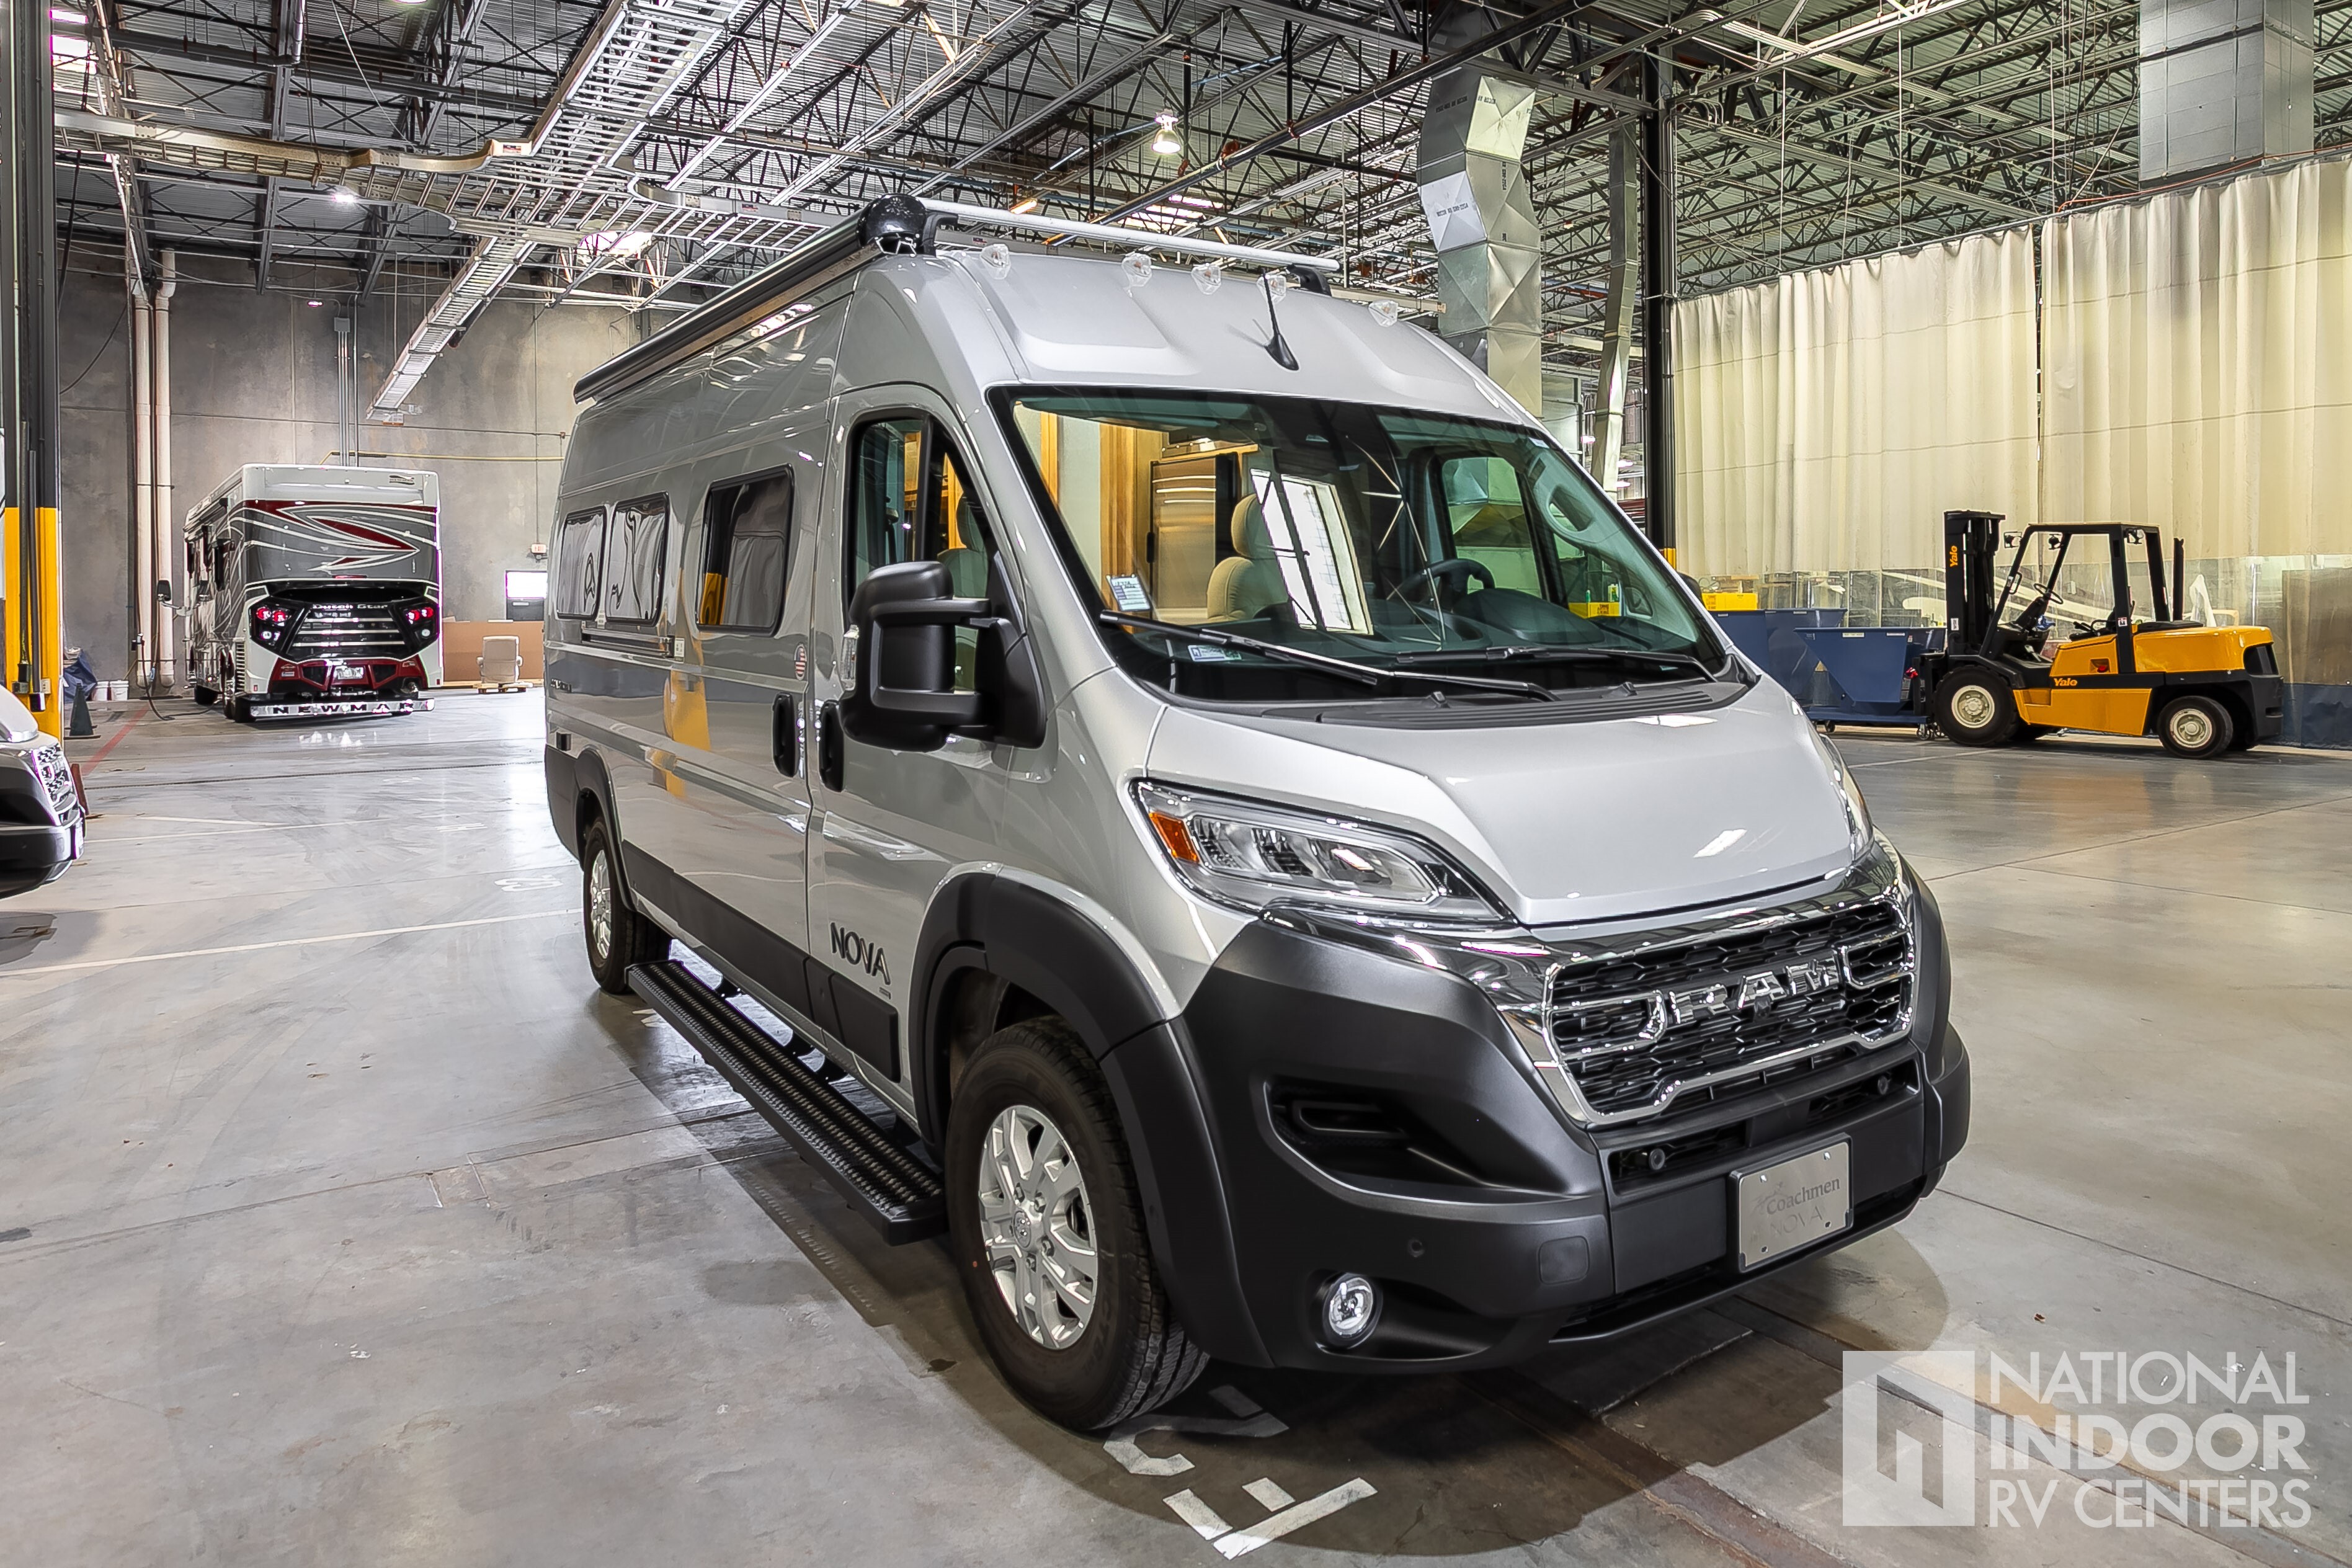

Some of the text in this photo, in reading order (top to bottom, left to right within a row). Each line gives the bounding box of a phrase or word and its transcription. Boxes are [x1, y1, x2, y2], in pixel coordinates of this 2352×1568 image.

[273, 702, 414, 714] NEWMAR
[830, 922, 891, 986] NOVA
[1669, 950, 1840, 1025] RAM
[1766, 1178, 1840, 1215] Coachmen
